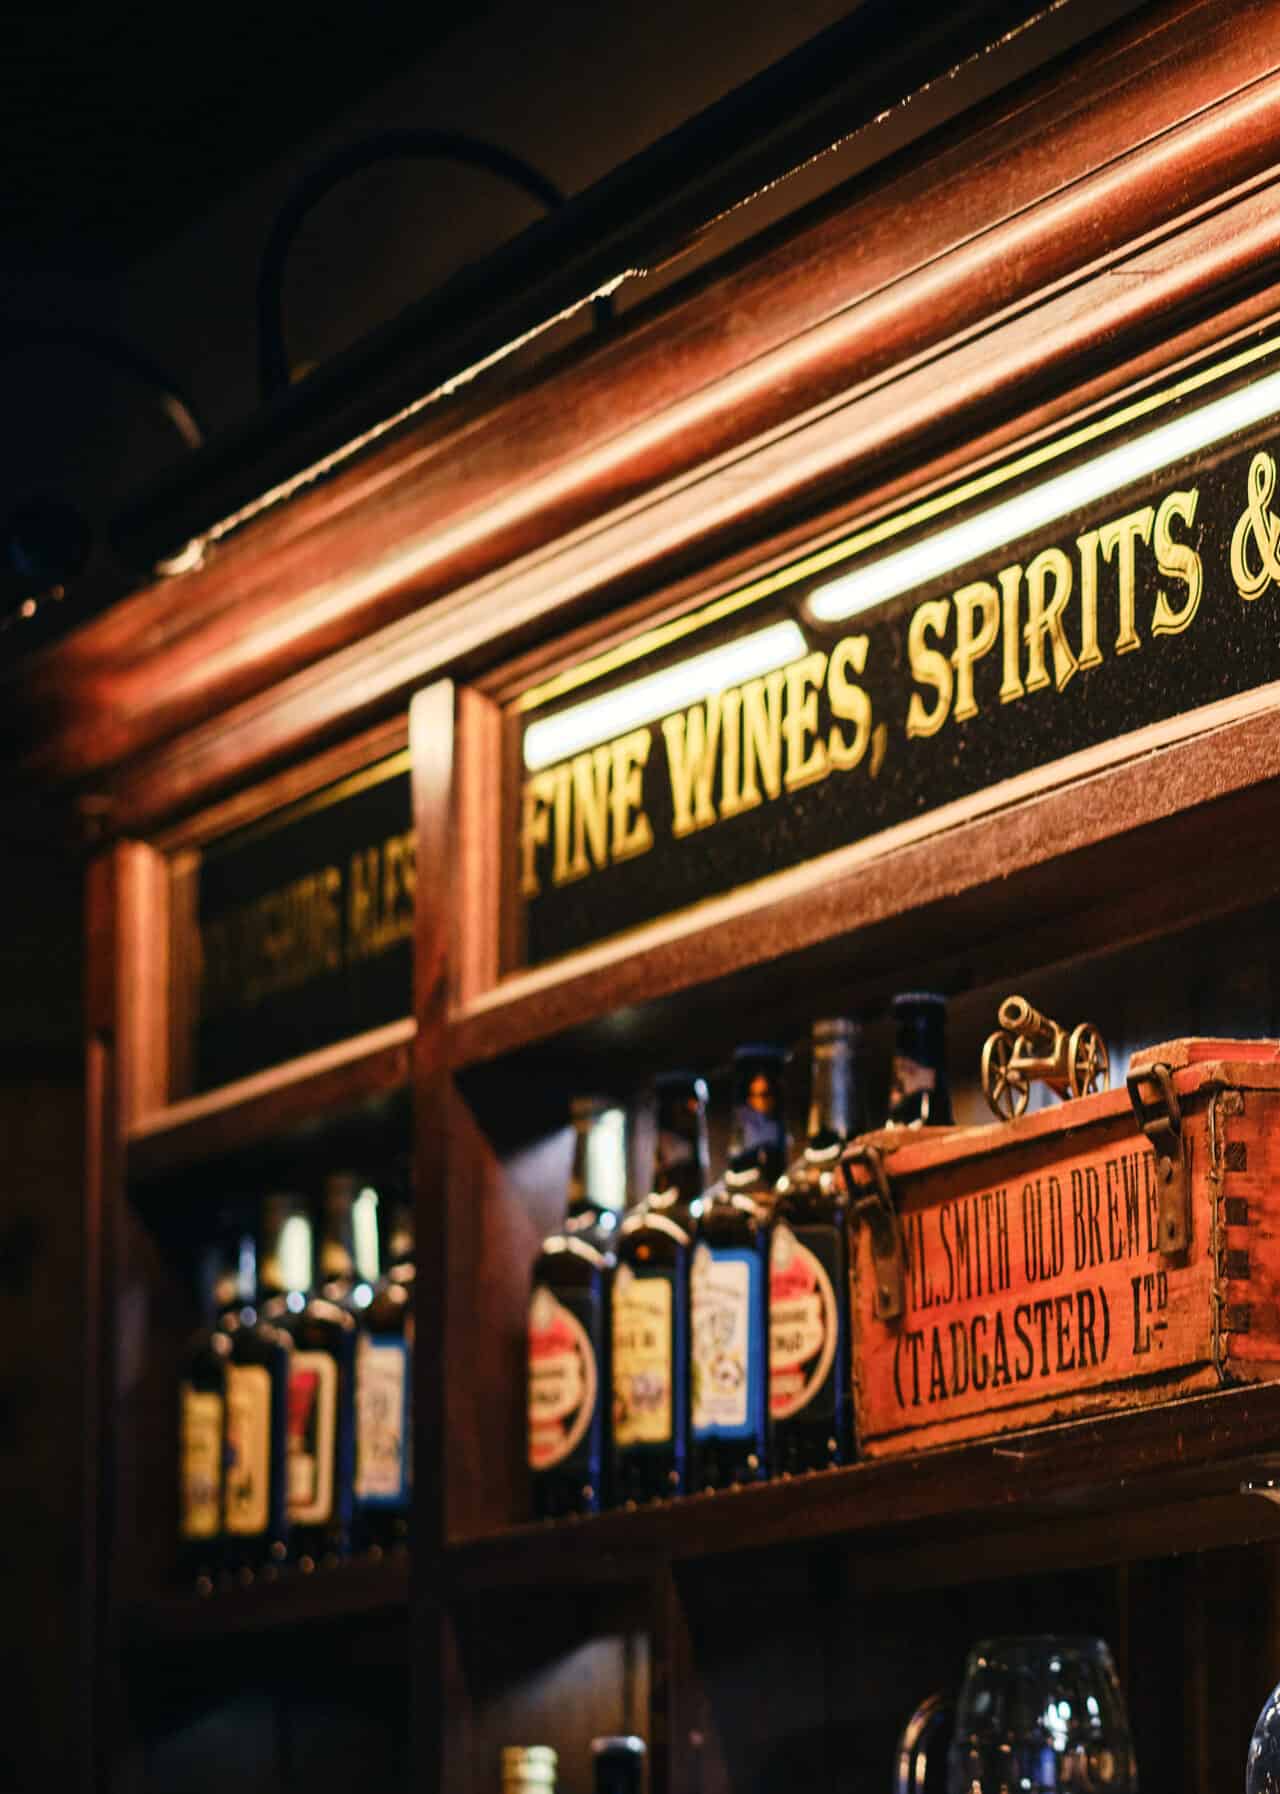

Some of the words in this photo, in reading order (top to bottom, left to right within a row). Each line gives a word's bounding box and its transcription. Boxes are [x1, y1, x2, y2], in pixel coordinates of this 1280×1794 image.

[520, 728, 653, 897] FINE
[662, 634, 887, 839] WINES,
[906, 488, 1203, 739] SPIRITS
[1022, 1175, 1064, 1283] OLD
[893, 1286, 1110, 1408] (TADCASTER)
